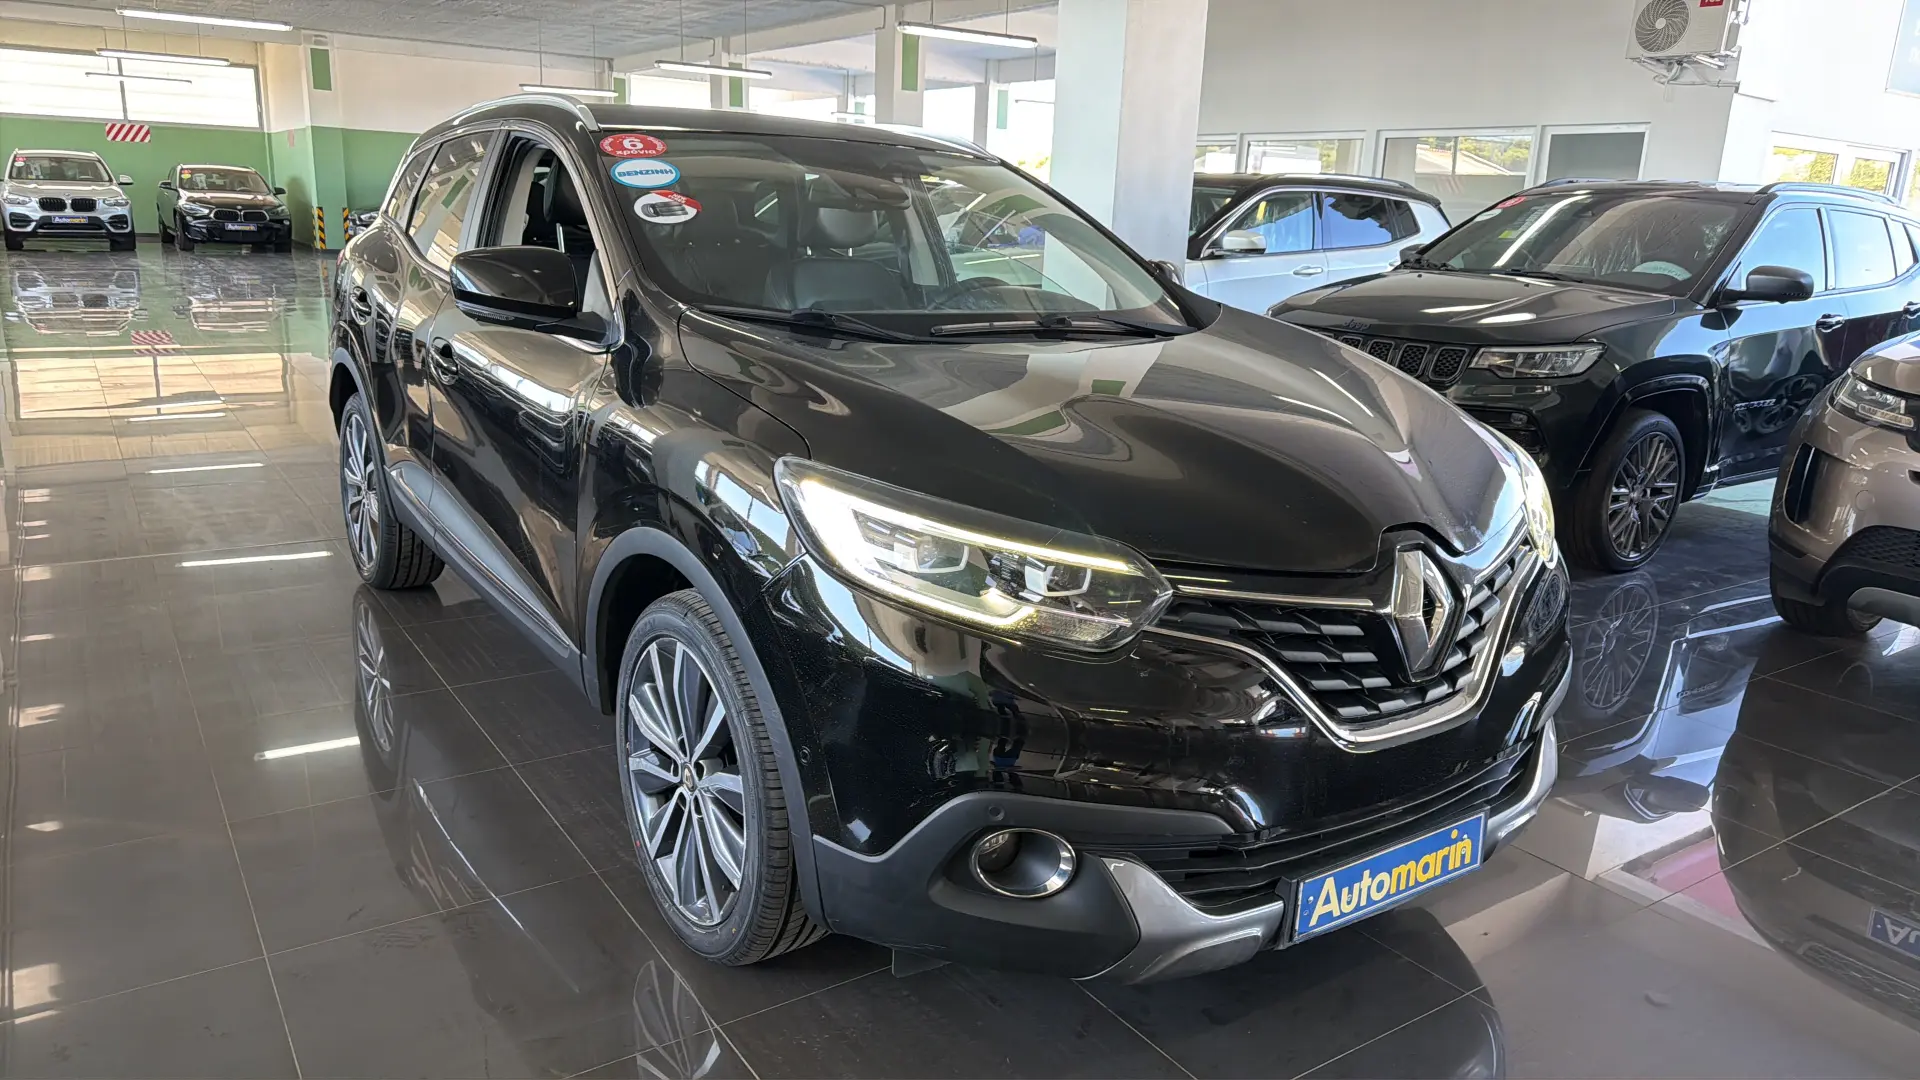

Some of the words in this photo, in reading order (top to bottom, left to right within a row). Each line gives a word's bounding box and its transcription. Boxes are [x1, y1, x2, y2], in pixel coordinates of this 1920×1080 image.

[622, 138, 643, 150] 6
[617, 169, 673, 177] ΒΕΝΖΙΝΗ
[1308, 829, 1472, 927] Automarin
